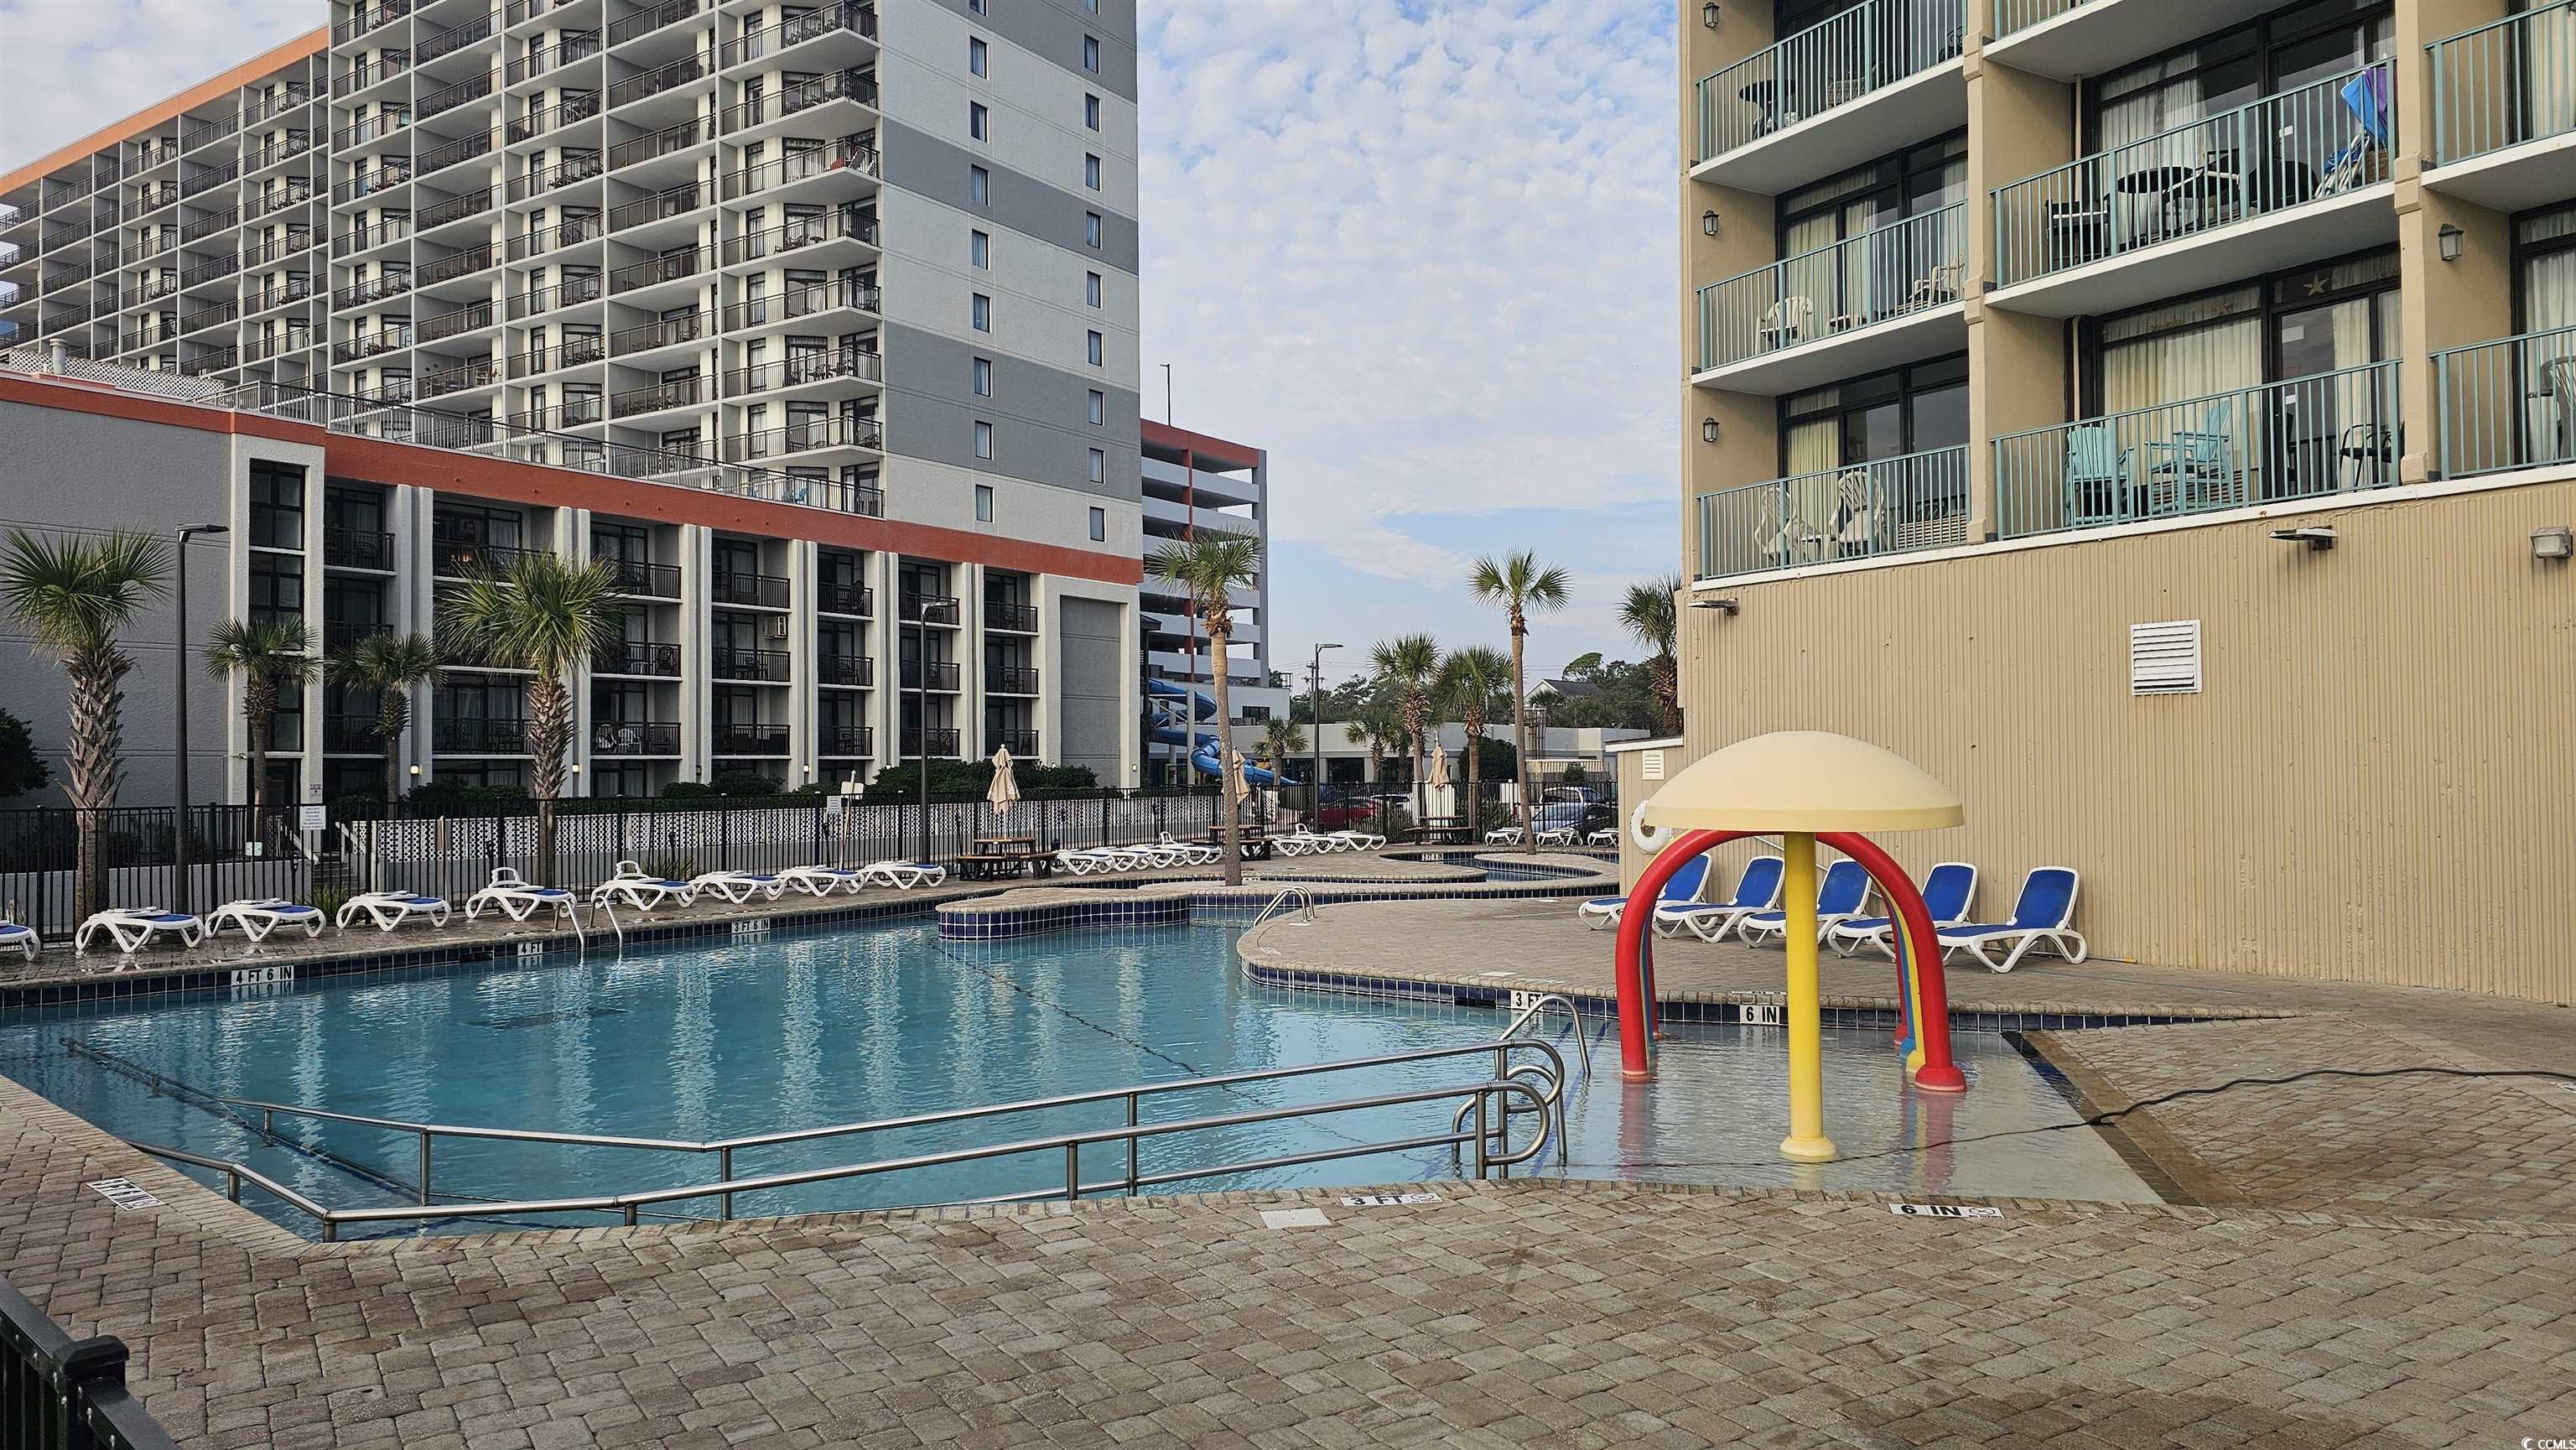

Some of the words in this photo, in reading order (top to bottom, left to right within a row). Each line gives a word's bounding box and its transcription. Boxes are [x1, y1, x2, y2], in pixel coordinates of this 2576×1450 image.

[735, 922, 739, 932] 3
[741, 922, 750, 931] FT
[753, 920, 758, 930] 6
[761, 919, 769, 929] IN
[522, 943, 527, 954] 4
[531, 941, 542, 954] FT
[236, 970, 243, 984] 4
[247, 969, 262, 983] FT
[267, 968, 274, 981] 6
[279, 966, 292, 980] IN
[1516, 992, 1523, 1007] 3
[1528, 993, 1541, 1008] FT
[1746, 1006, 1754, 1022] 6
[1762, 1006, 1777, 1023] IN
[1350, 1197, 1367, 1205] 3
[1375, 1195, 1403, 1204] FT
[1901, 1204, 1918, 1214] 6
[1929, 1206, 1962, 1216] IN
